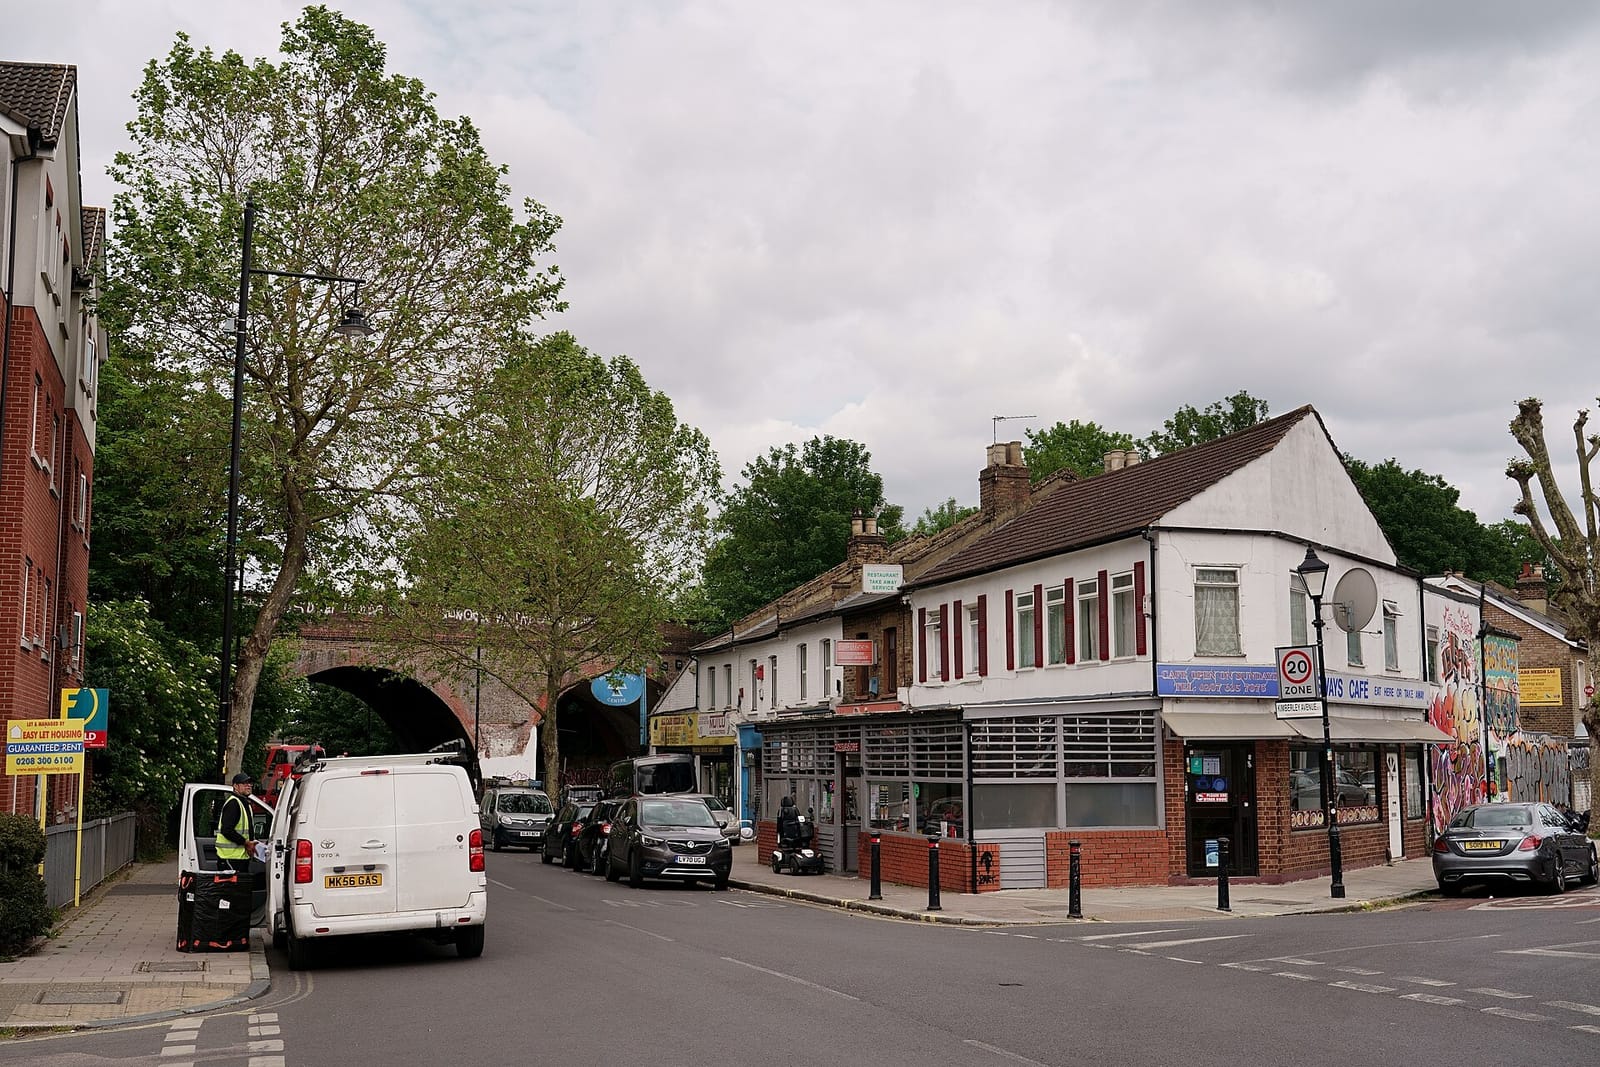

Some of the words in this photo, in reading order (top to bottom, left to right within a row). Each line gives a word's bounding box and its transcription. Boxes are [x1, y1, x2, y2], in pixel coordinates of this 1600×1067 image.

[1287, 660, 1308, 674] 20
[1190, 671, 1216, 680] OPEN
[1284, 686, 1313, 695] ZONE
[1384, 687, 1394, 697] HERE
[1396, 688, 1402, 697] OR
[1404, 689, 1413, 698] TAKE
[1277, 703, 1300, 711] KIMBERLEY
[1300, 702, 1317, 710] AVENUE
[23, 731, 38, 739] EASY
[39, 731, 50, 739] LET
[51, 730, 82, 738] HOUSING
[8, 743, 60, 753] GUARANTEED
[62, 743, 82, 751] RENT
[16, 757, 35, 765] 0208
[37, 757, 52, 765] 300
[54, 756, 74, 764] 6100
[358, 876, 378, 885] GAS
